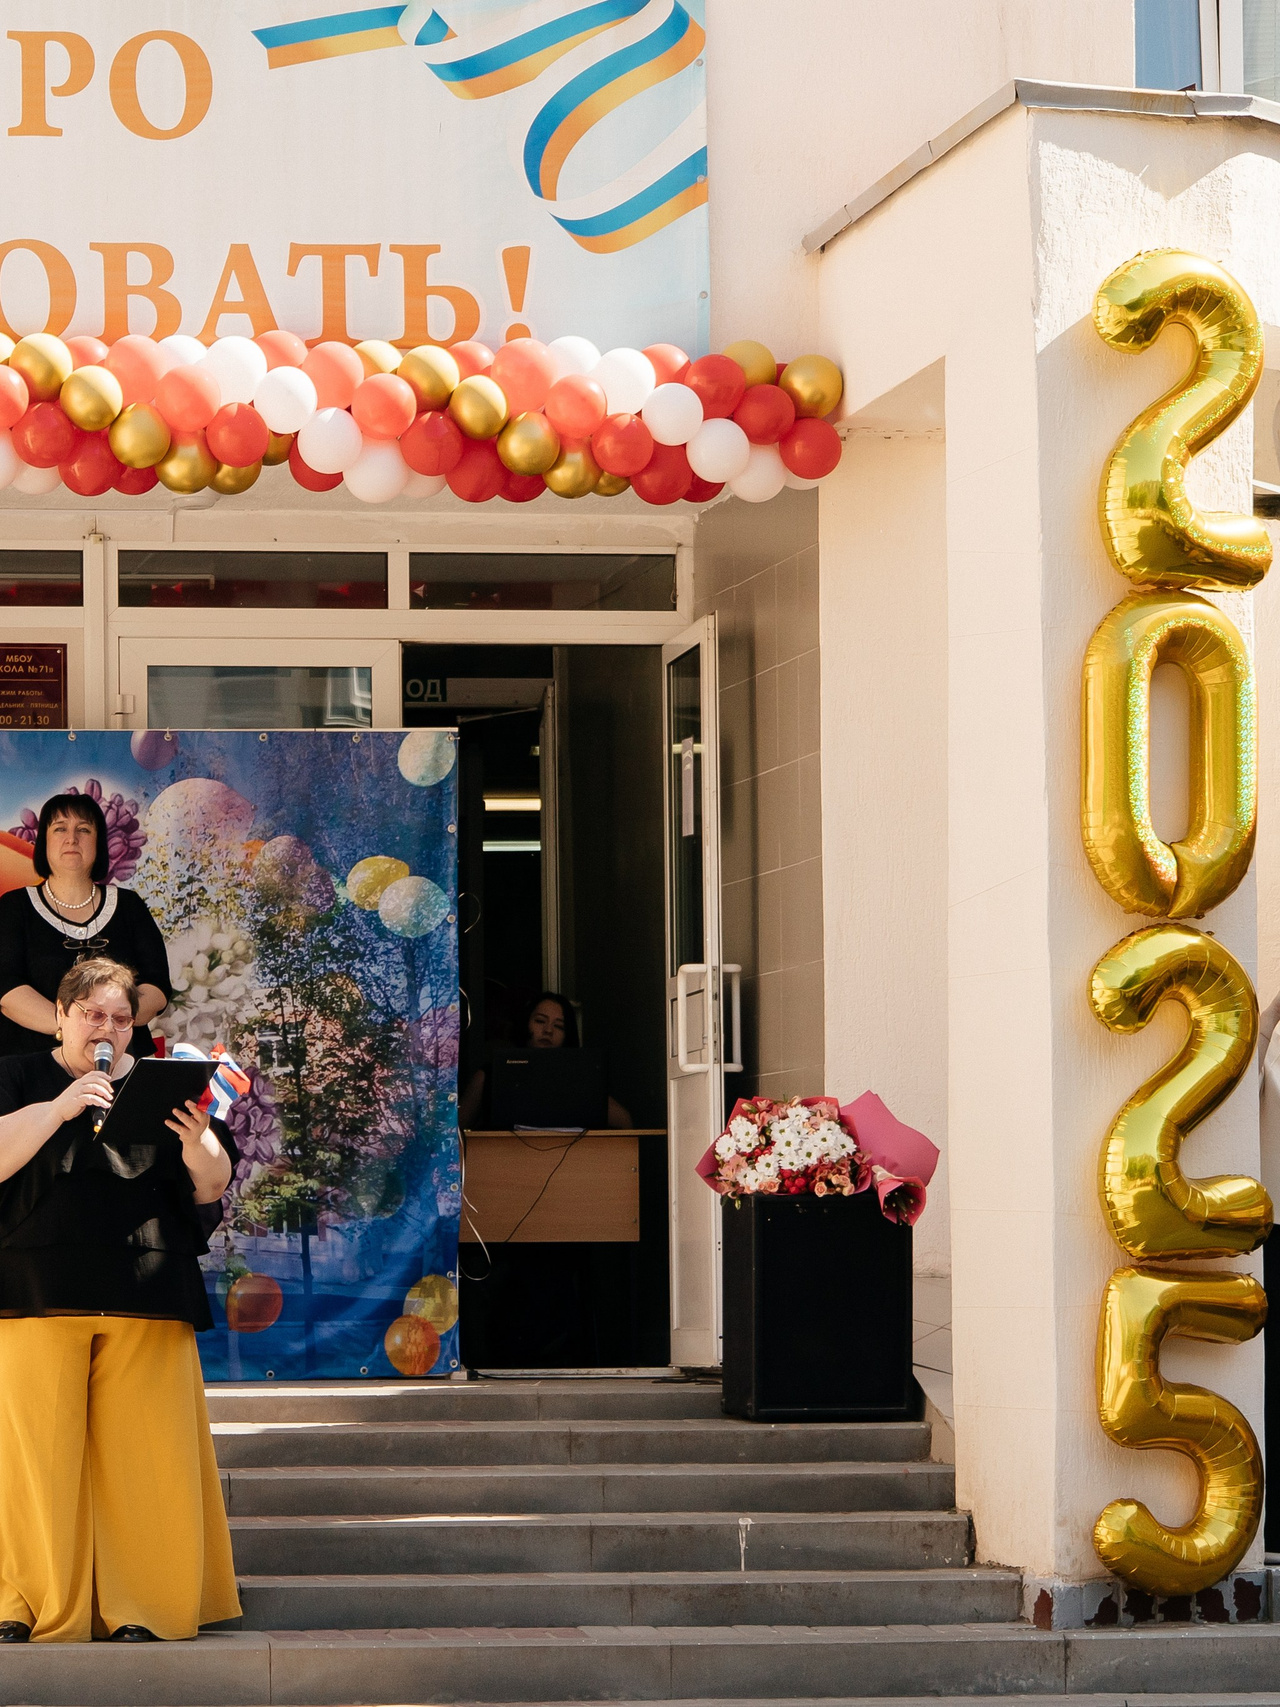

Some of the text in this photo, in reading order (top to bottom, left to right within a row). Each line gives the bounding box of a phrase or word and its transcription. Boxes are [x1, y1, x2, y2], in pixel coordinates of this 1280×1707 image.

[6, 655, 33, 663] МБОУ
[406, 679, 441, 701] ОД
[20, 715, 50, 725] 21.30
[1082, 247, 1274, 1597] 2025
